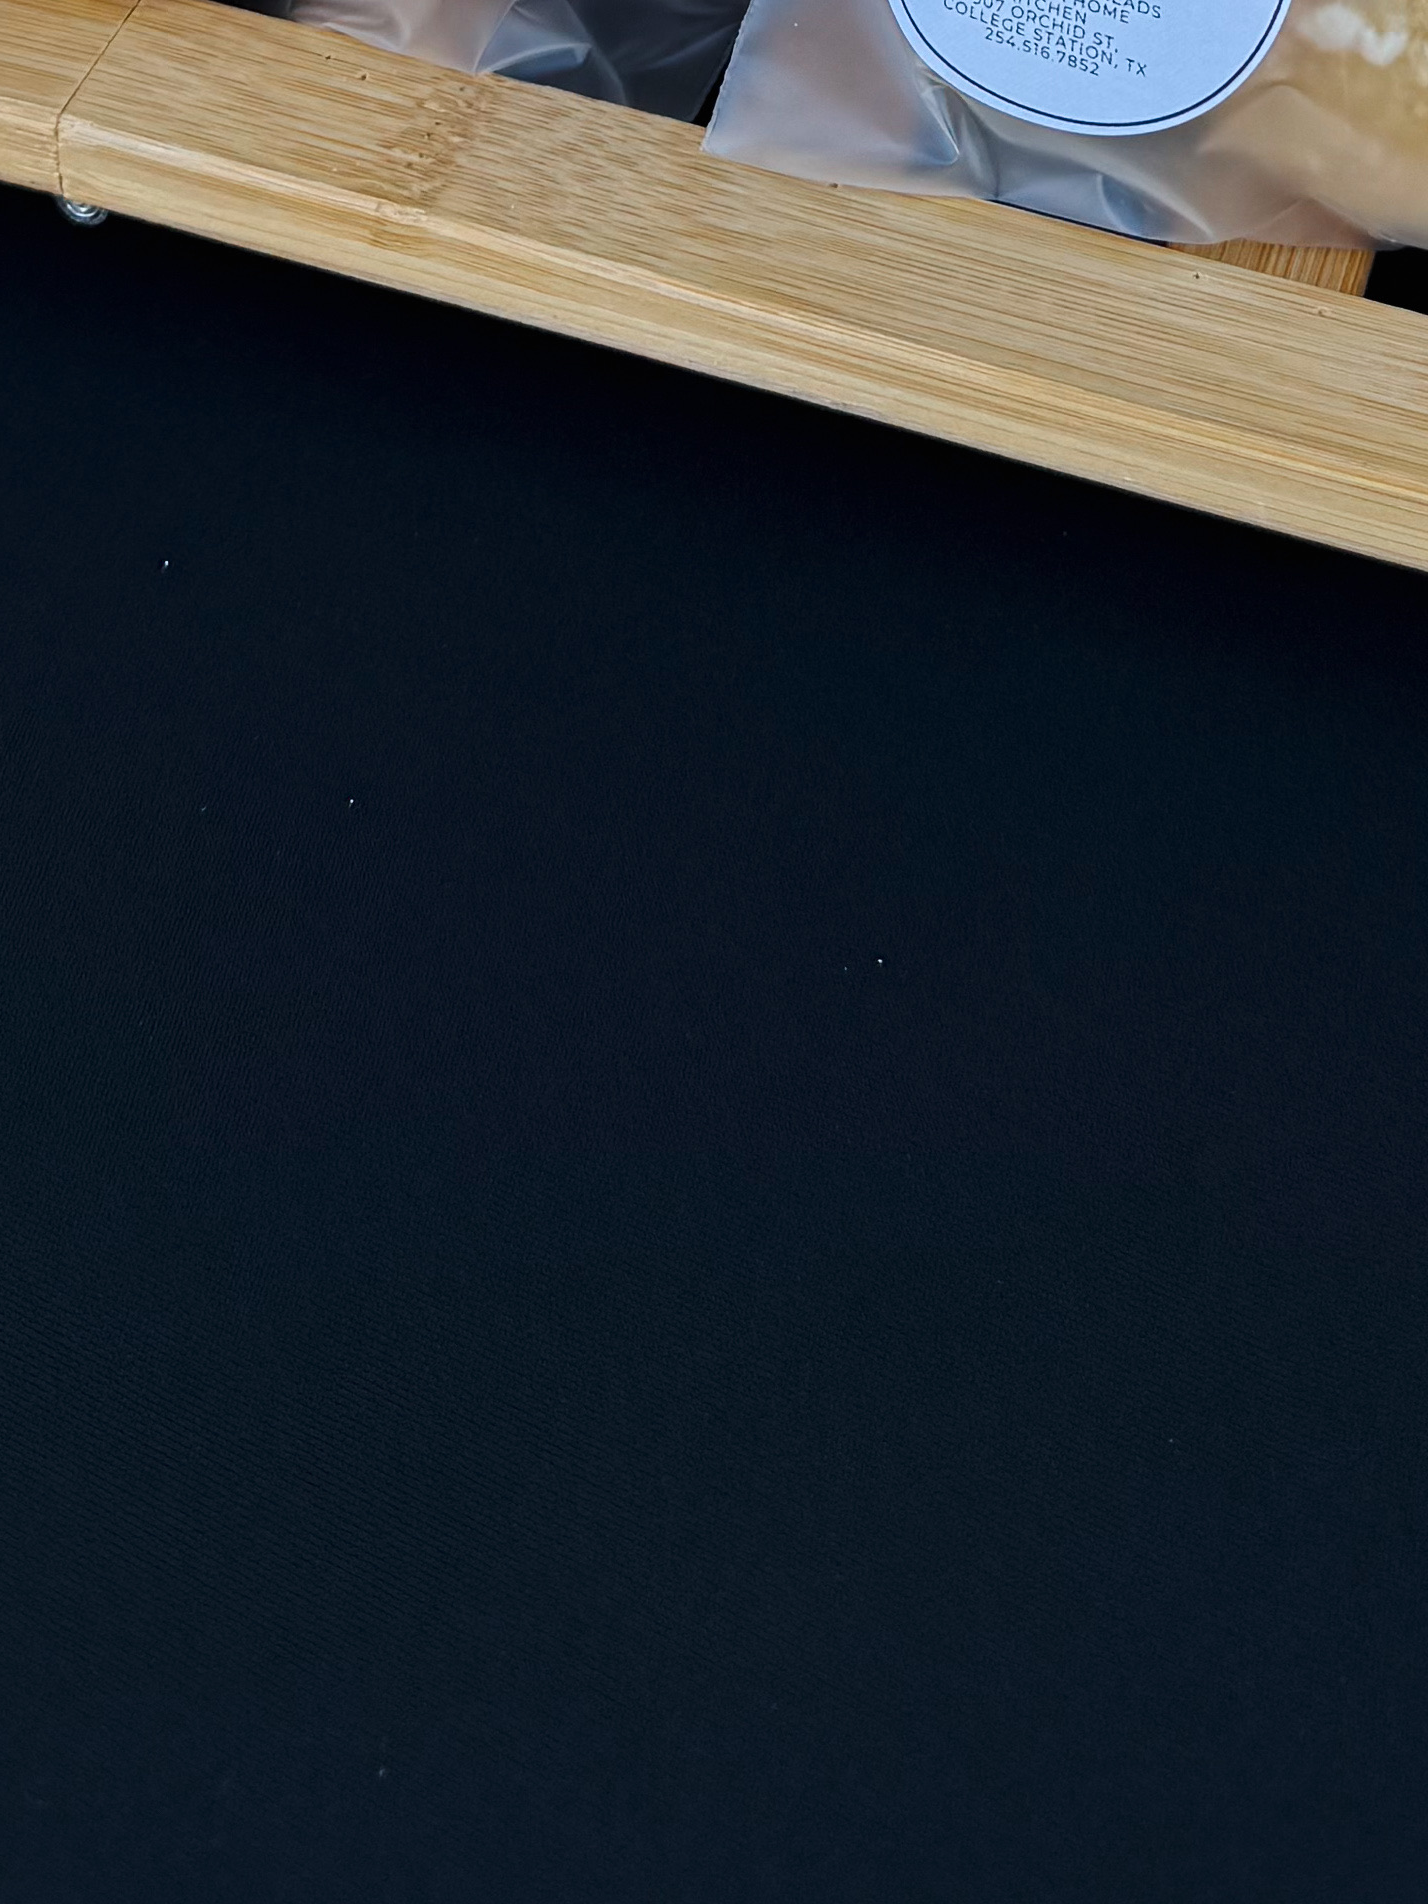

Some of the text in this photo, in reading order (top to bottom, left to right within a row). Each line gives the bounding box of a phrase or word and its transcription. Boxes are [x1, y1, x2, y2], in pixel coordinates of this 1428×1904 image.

[1012, 6, 1085, 39] ORCHID
[985, 27, 1099, 76] 254.516.7852
[1034, 28, 1118, 68] STATION,
[1126, 59, 1147, 77] TX
